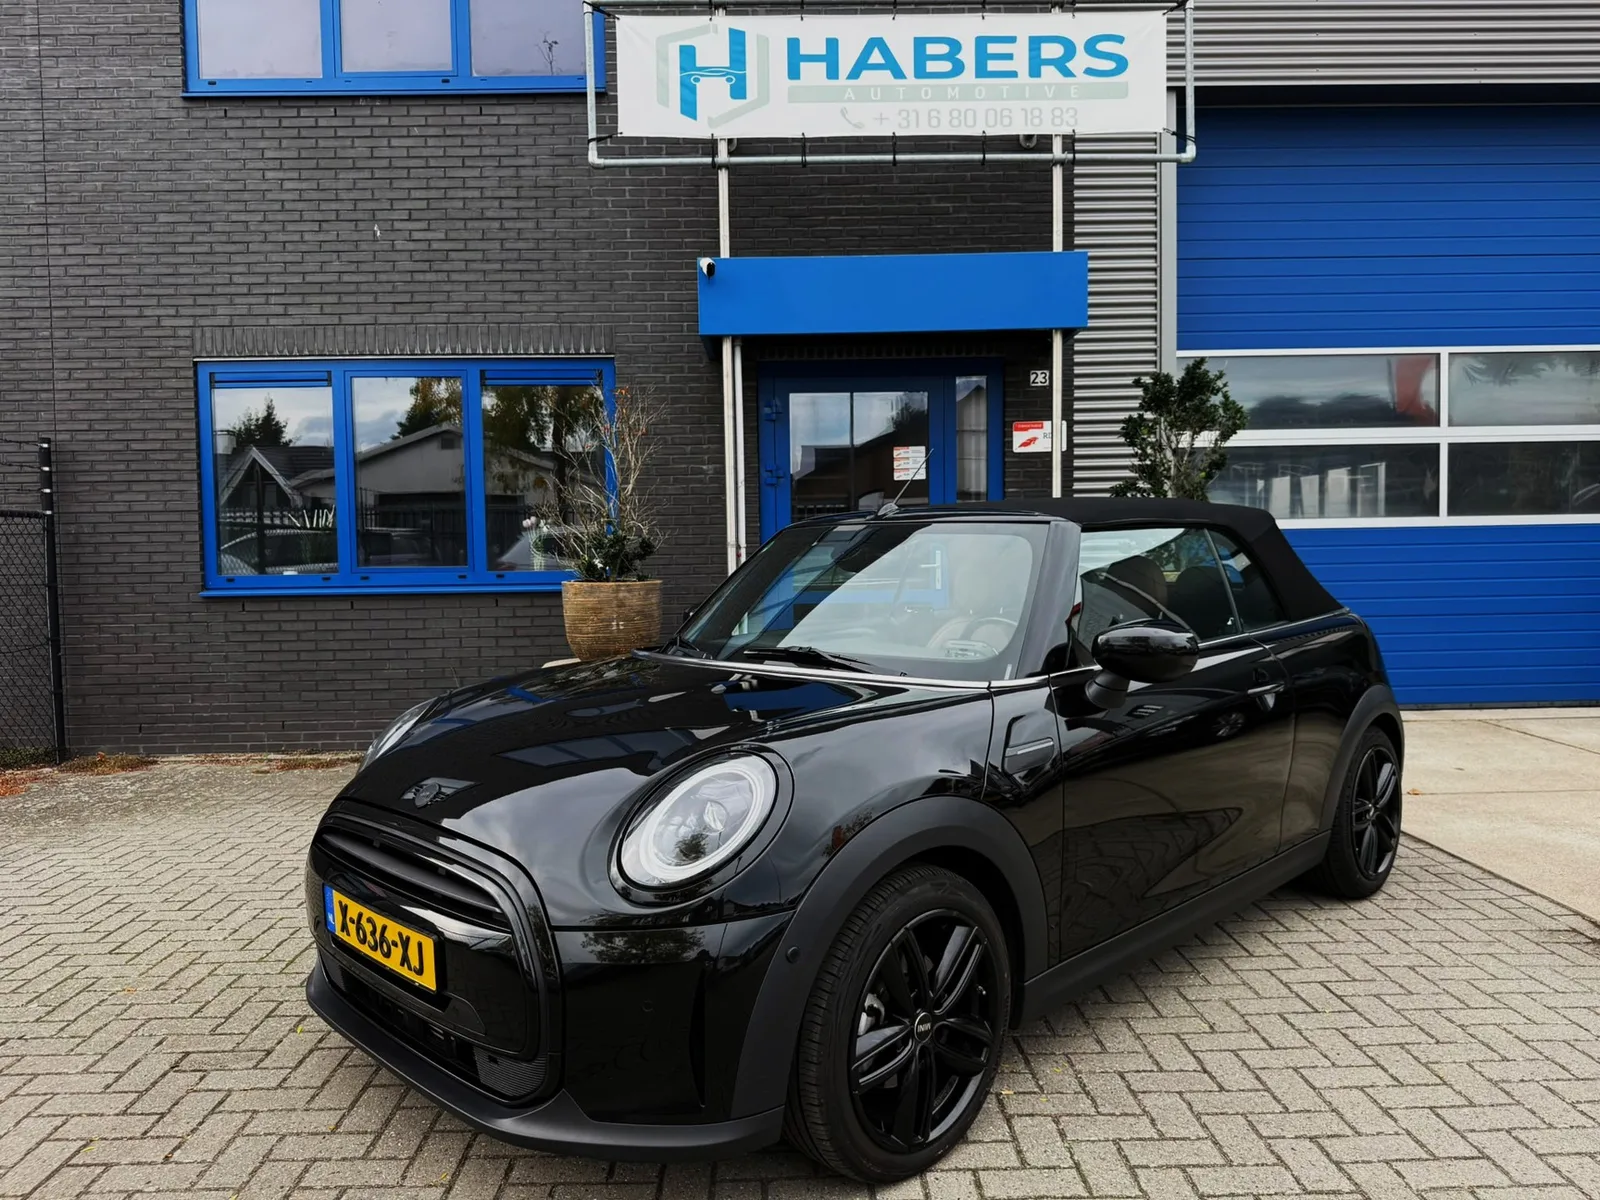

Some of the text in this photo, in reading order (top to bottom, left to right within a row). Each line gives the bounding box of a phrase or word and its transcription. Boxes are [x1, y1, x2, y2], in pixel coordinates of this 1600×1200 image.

[787, 34, 1129, 80] HABERS
[843, 84, 1080, 101] AUTOMOTIVE
[898, 108, 920, 129] 31
[927, 107, 941, 129] 6
[948, 107, 977, 128] 80
[985, 107, 1013, 128] 06
[1020, 106, 1043, 127] 18
[1051, 106, 1078, 128] 83
[1031, 371, 1048, 385] 23
[338, 899, 424, 977] X-636-XJ
